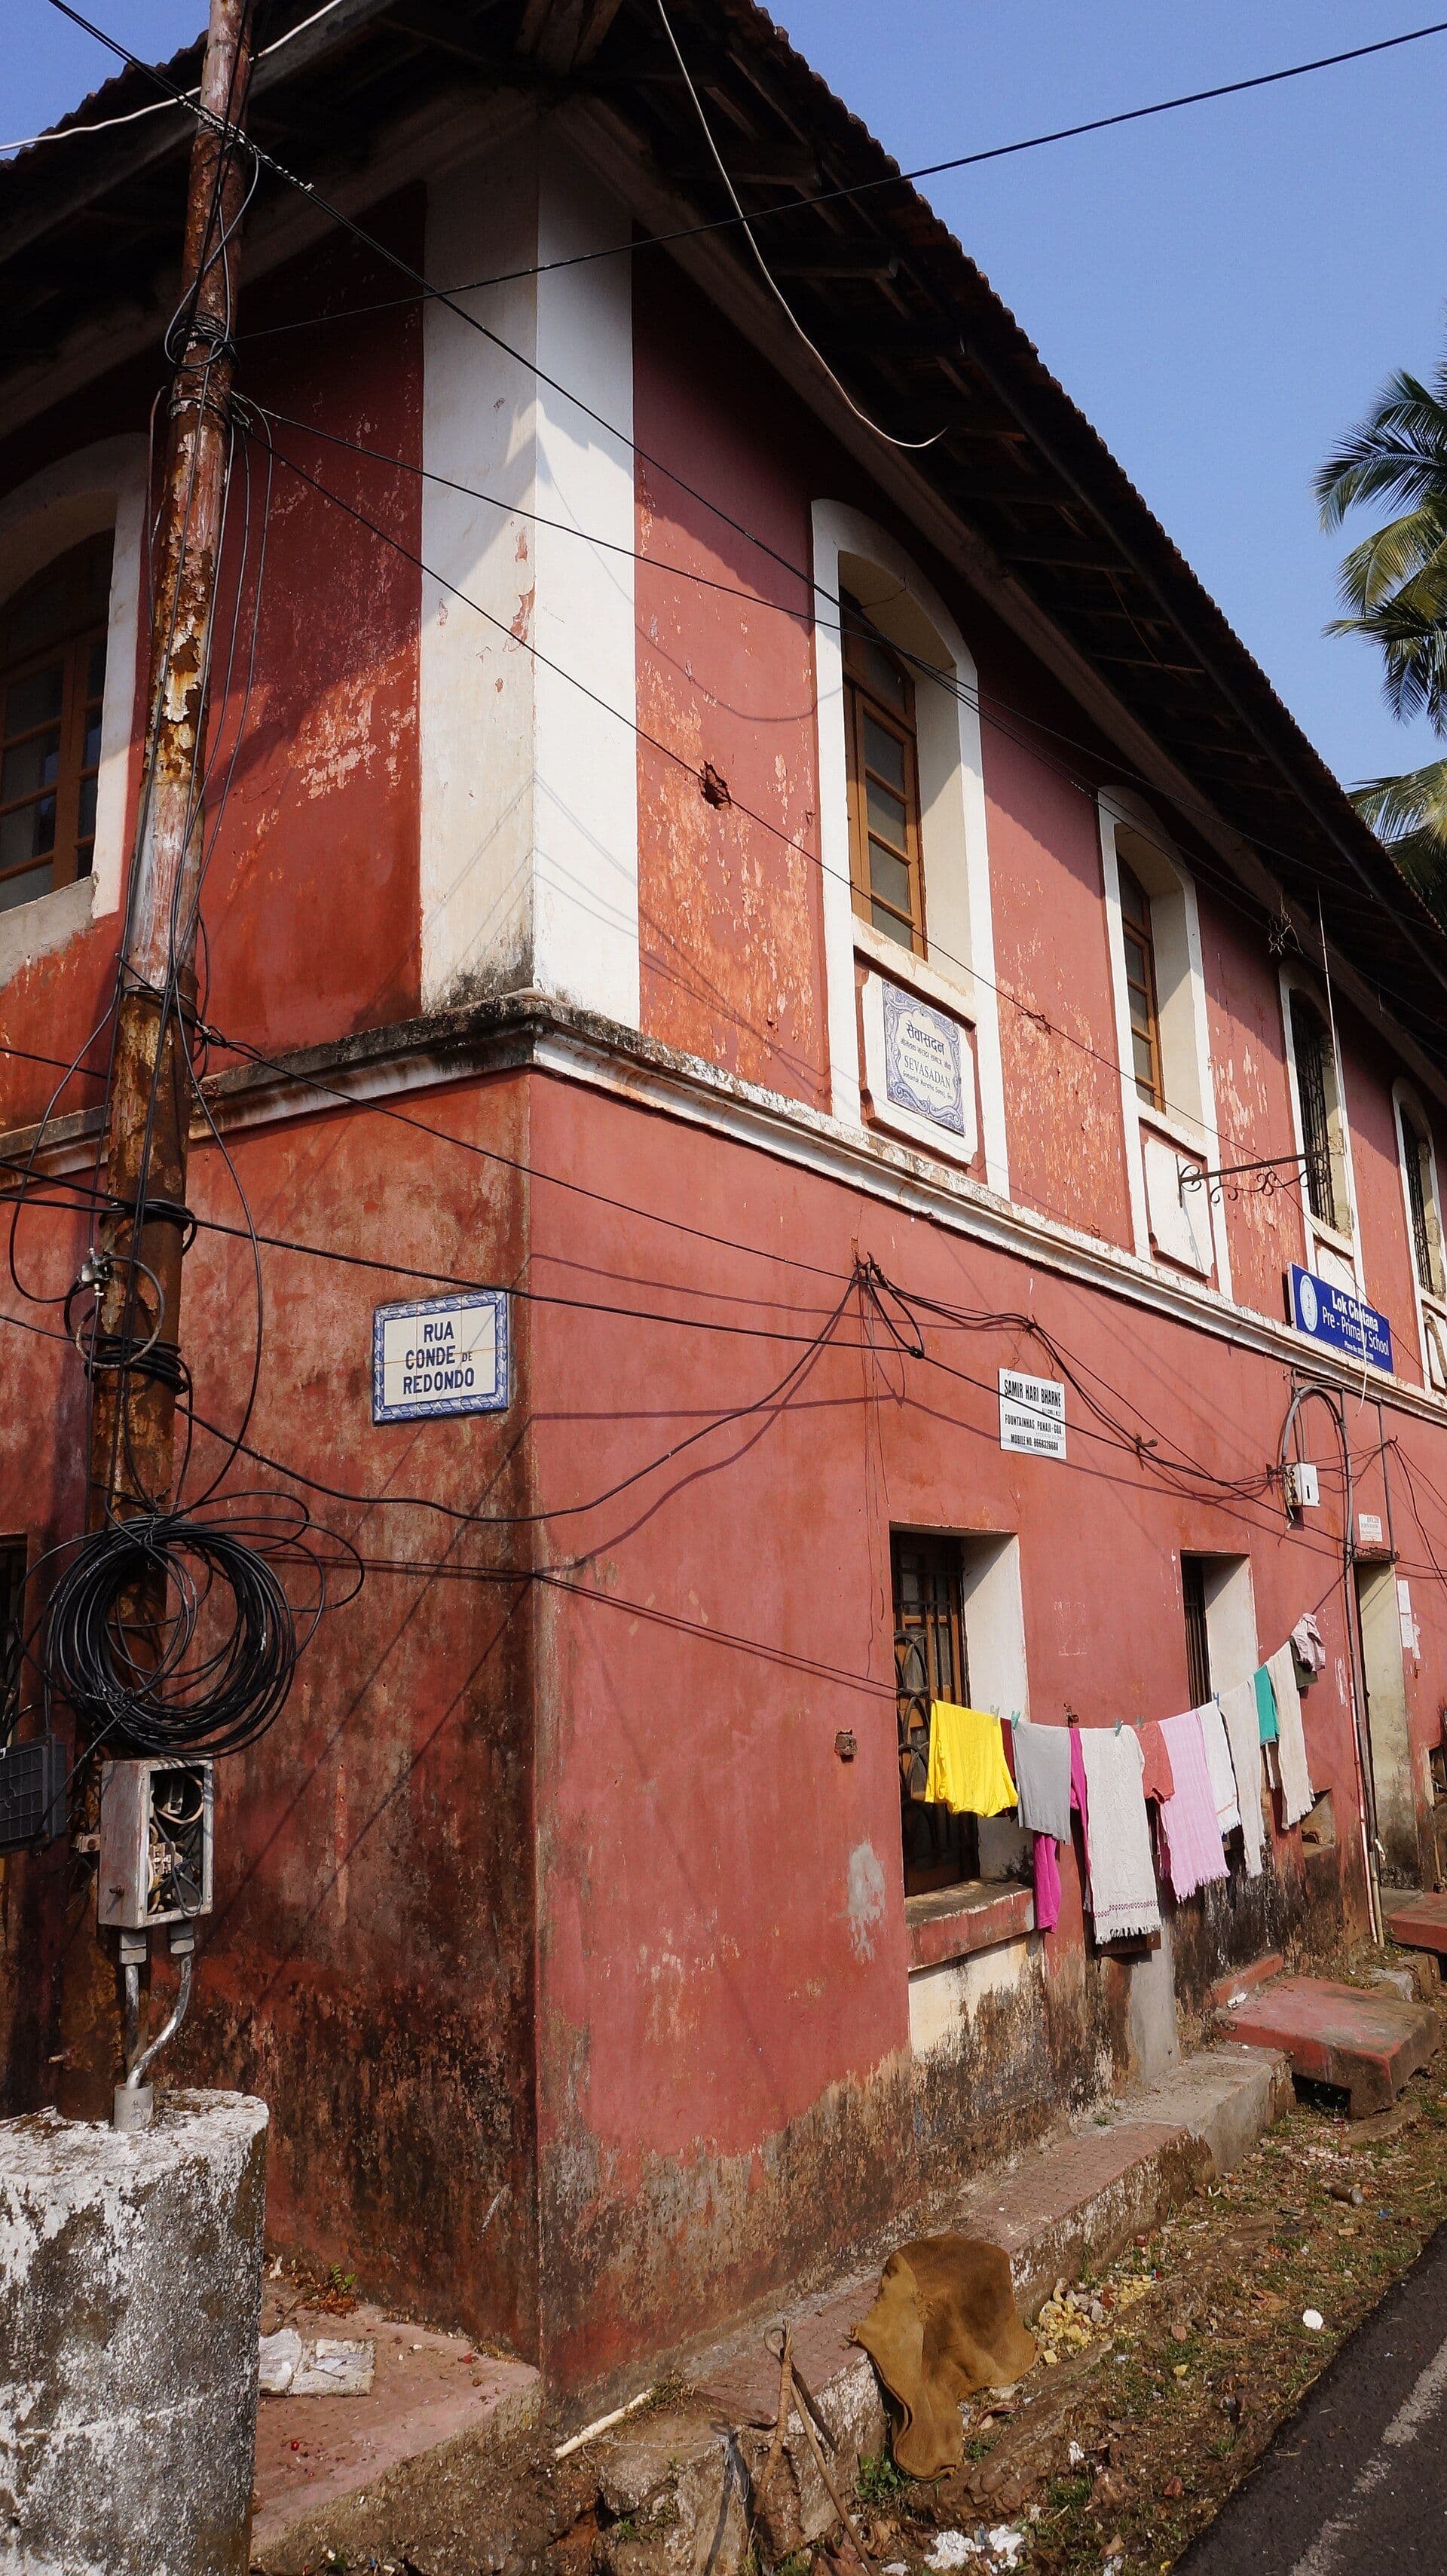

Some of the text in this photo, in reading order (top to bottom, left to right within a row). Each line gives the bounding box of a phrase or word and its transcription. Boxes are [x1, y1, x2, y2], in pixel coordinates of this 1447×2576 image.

[906, 1020, 944, 1055] सेवासदन
[904, 1055, 950, 1089] SEVASADAN
[1331, 1290, 1348, 1315] Lok
[424, 1321, 454, 1343] RUA
[1322, 1306, 1335, 1328] Pre
[1341, 1316, 1368, 1349] Primay
[1368, 1331, 1390, 1356] School
[405, 1345, 473, 1370] CONDE DE
[403, 1368, 474, 1395] REDONDO
[1004, 1380, 1061, 1407] SAMIR HARI BHARNE
[1011, 1434, 1025, 1445] MOBILE
